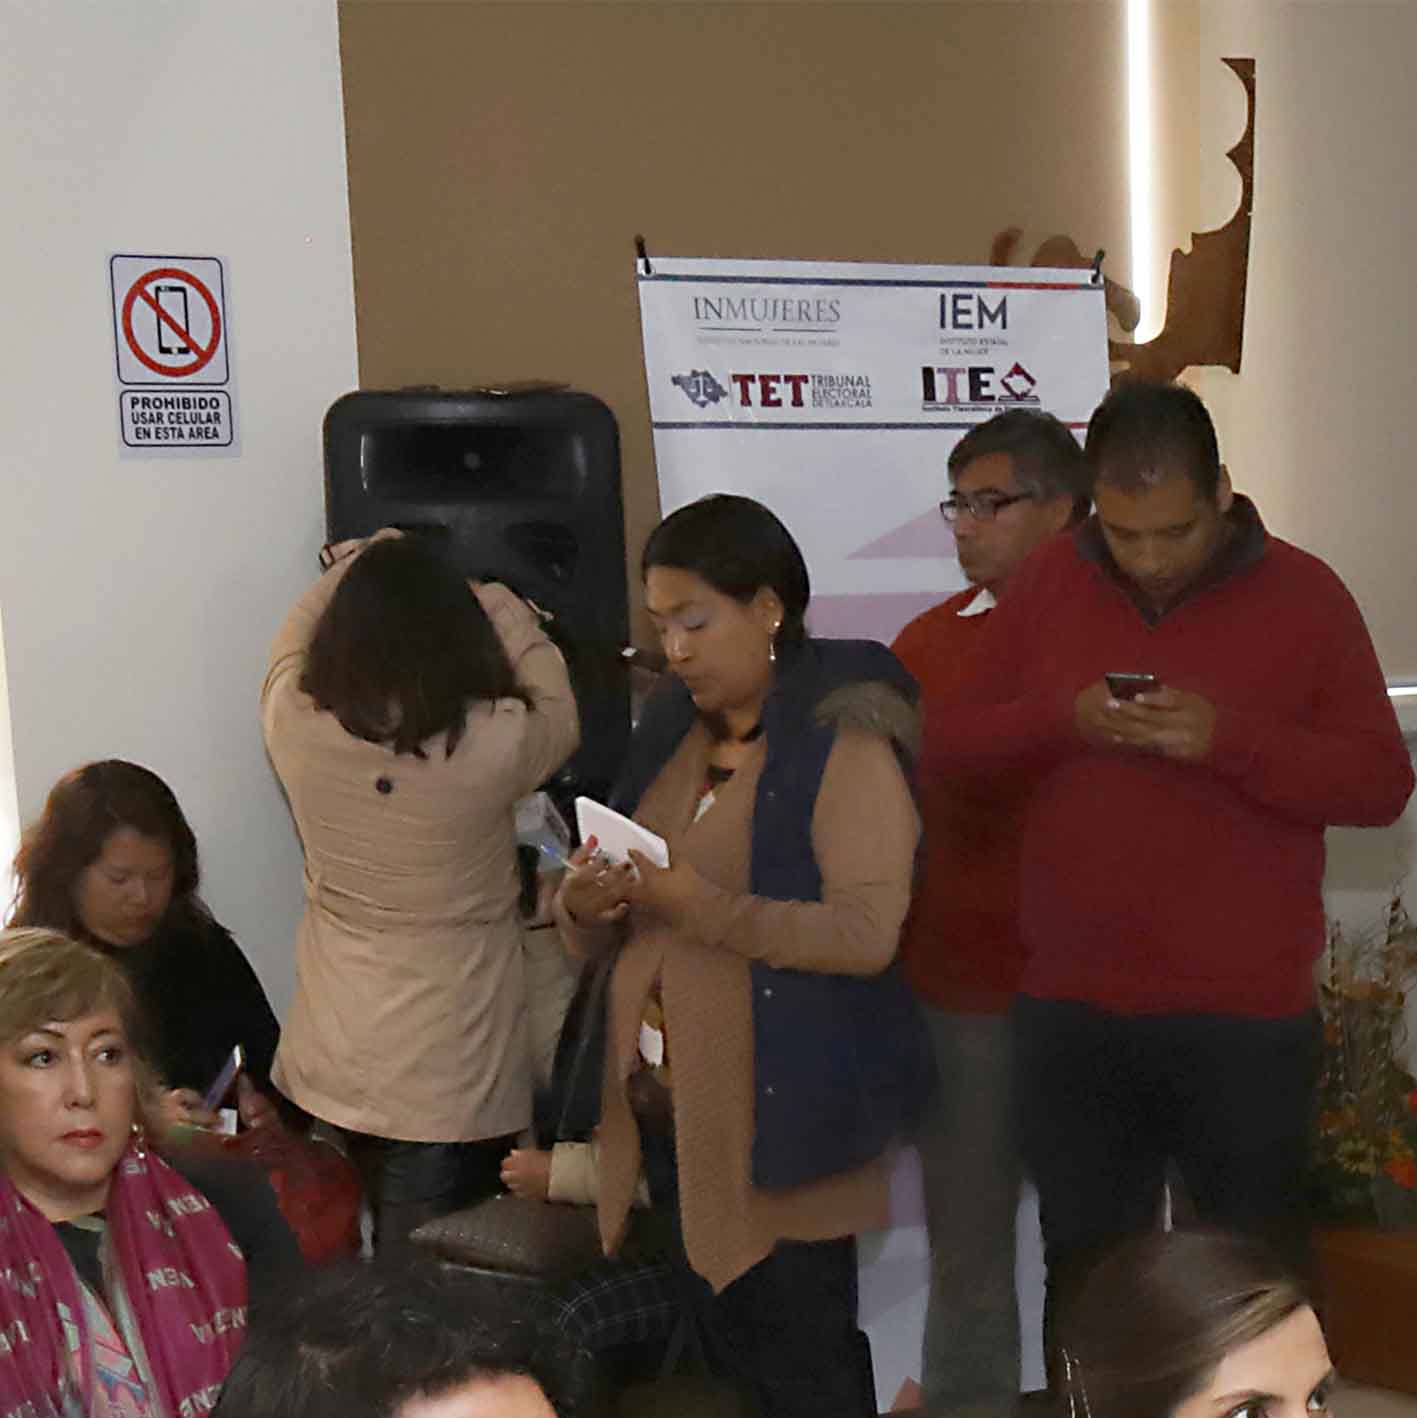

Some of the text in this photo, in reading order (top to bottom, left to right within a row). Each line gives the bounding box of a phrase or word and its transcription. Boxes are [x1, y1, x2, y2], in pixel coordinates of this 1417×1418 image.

[694, 296, 841, 323] INMUJERES
[940, 293, 1007, 330] IEM
[811, 374, 872, 389] TRIBUNAL
[731, 373, 809, 408] TET
[812, 388, 872, 401] ELECTORAL
[130, 396, 221, 410] PROHIBIDO
[131, 412, 222, 426] USAR CELULAR
[135, 427, 220, 441] EN ESTA AREA
